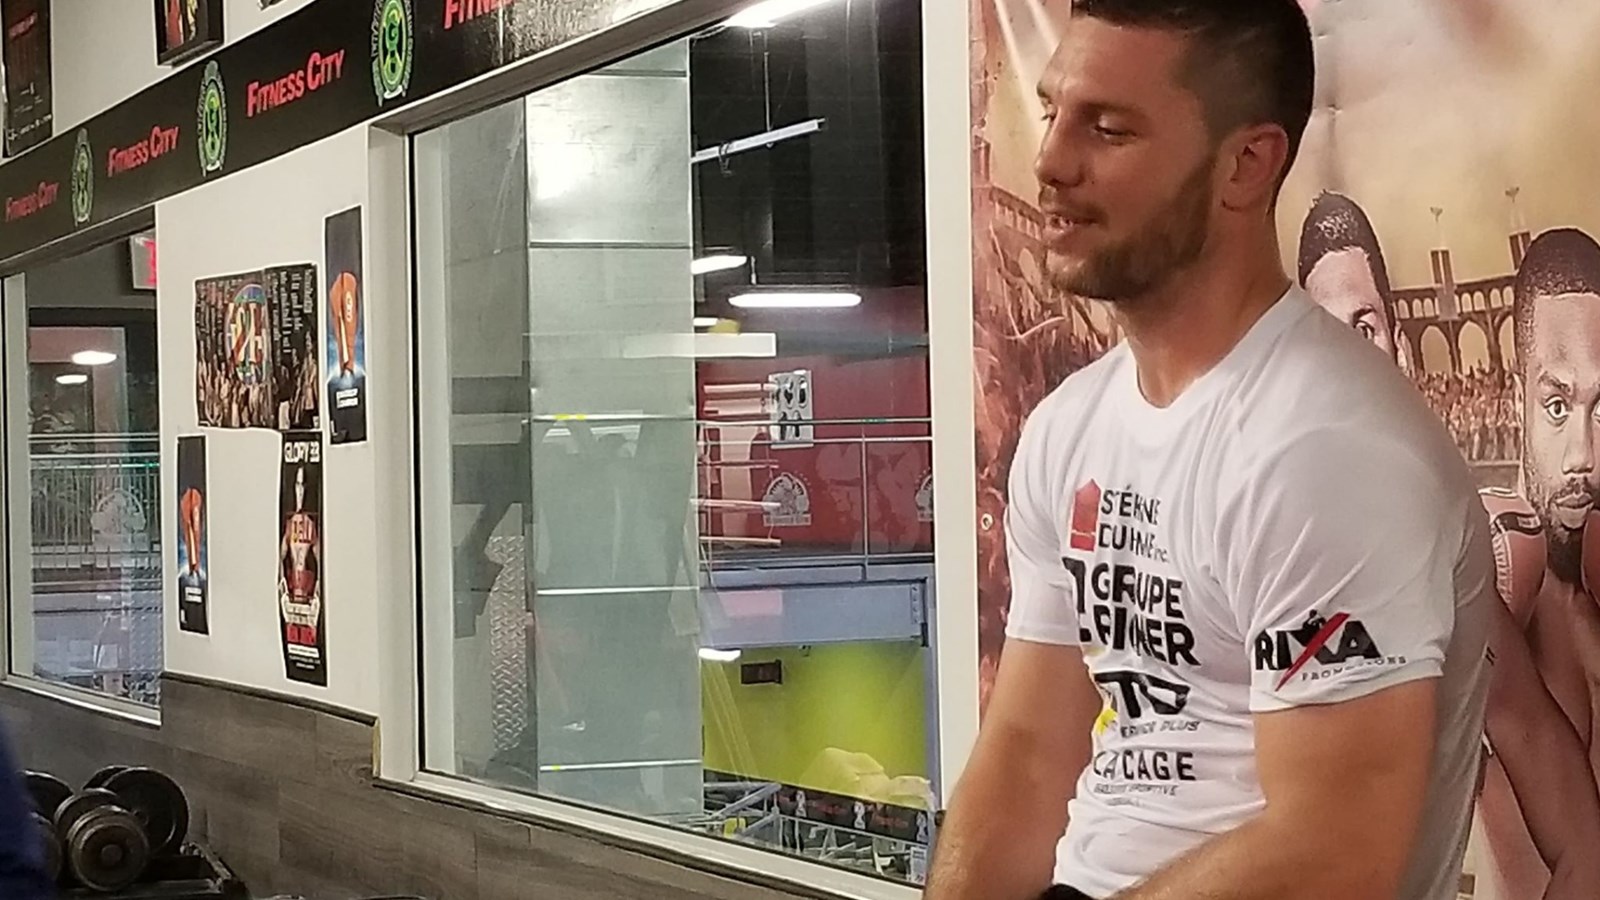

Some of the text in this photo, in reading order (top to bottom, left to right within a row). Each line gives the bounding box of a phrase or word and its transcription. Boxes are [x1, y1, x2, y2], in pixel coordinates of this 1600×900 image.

[246, 70, 305, 117] FITNESS
[306, 50, 345, 90] CITY
[1122, 750, 1196, 781] CAGE
